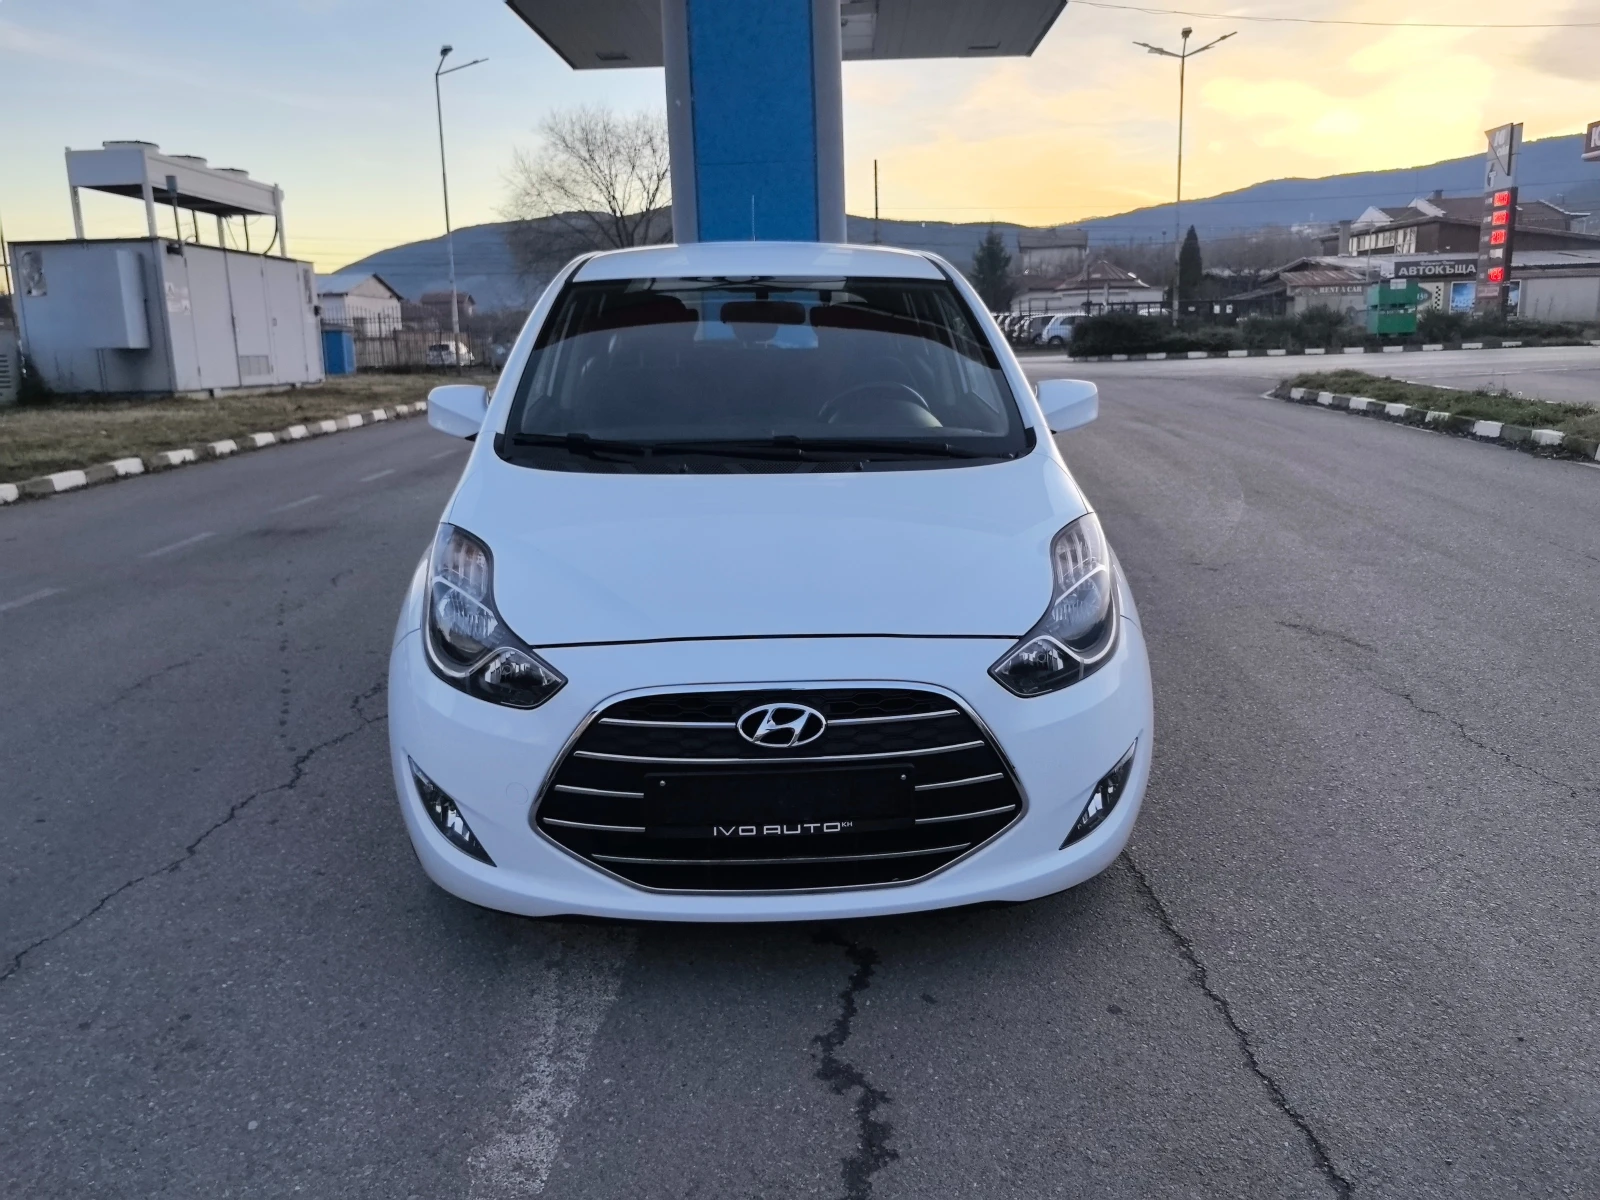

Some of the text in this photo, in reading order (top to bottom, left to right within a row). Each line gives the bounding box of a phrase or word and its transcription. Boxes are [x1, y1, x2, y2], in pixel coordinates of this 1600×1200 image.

[1398, 264, 1477, 276] АВТОКЪЩА
[1320, 286, 1340, 294] RENT
[1347, 285, 1363, 293] CAR
[713, 825, 756, 836] IVO
